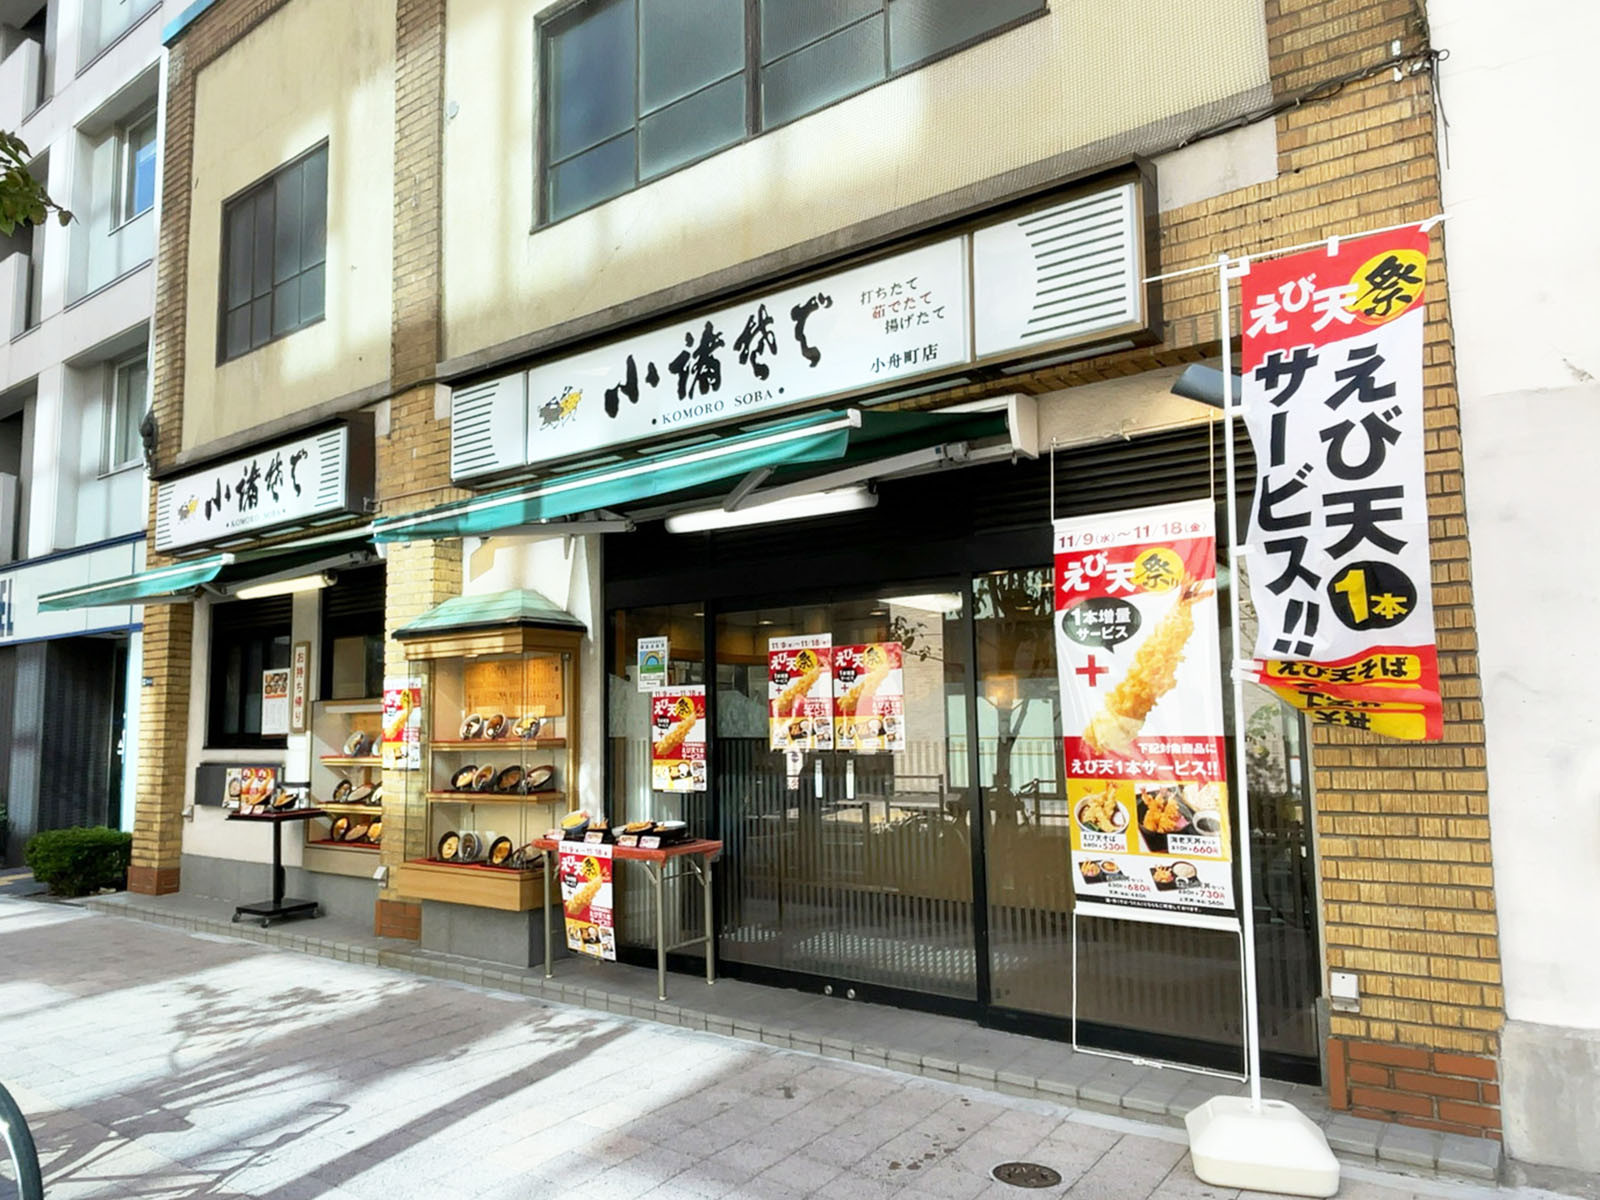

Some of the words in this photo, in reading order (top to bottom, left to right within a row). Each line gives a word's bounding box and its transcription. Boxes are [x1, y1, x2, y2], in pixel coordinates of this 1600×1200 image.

[861, 277, 918, 305] 打ちたて
[872, 291, 932, 319] 茹でたて
[885, 306, 945, 334] 揚げたて
[870, 344, 938, 373] 小舟町店
[662, 399, 725, 425] KOMORO
[734, 389, 773, 406] SOBA
[1071, 607, 1131, 626] 1本増量
[1076, 626, 1129, 641] サービス
